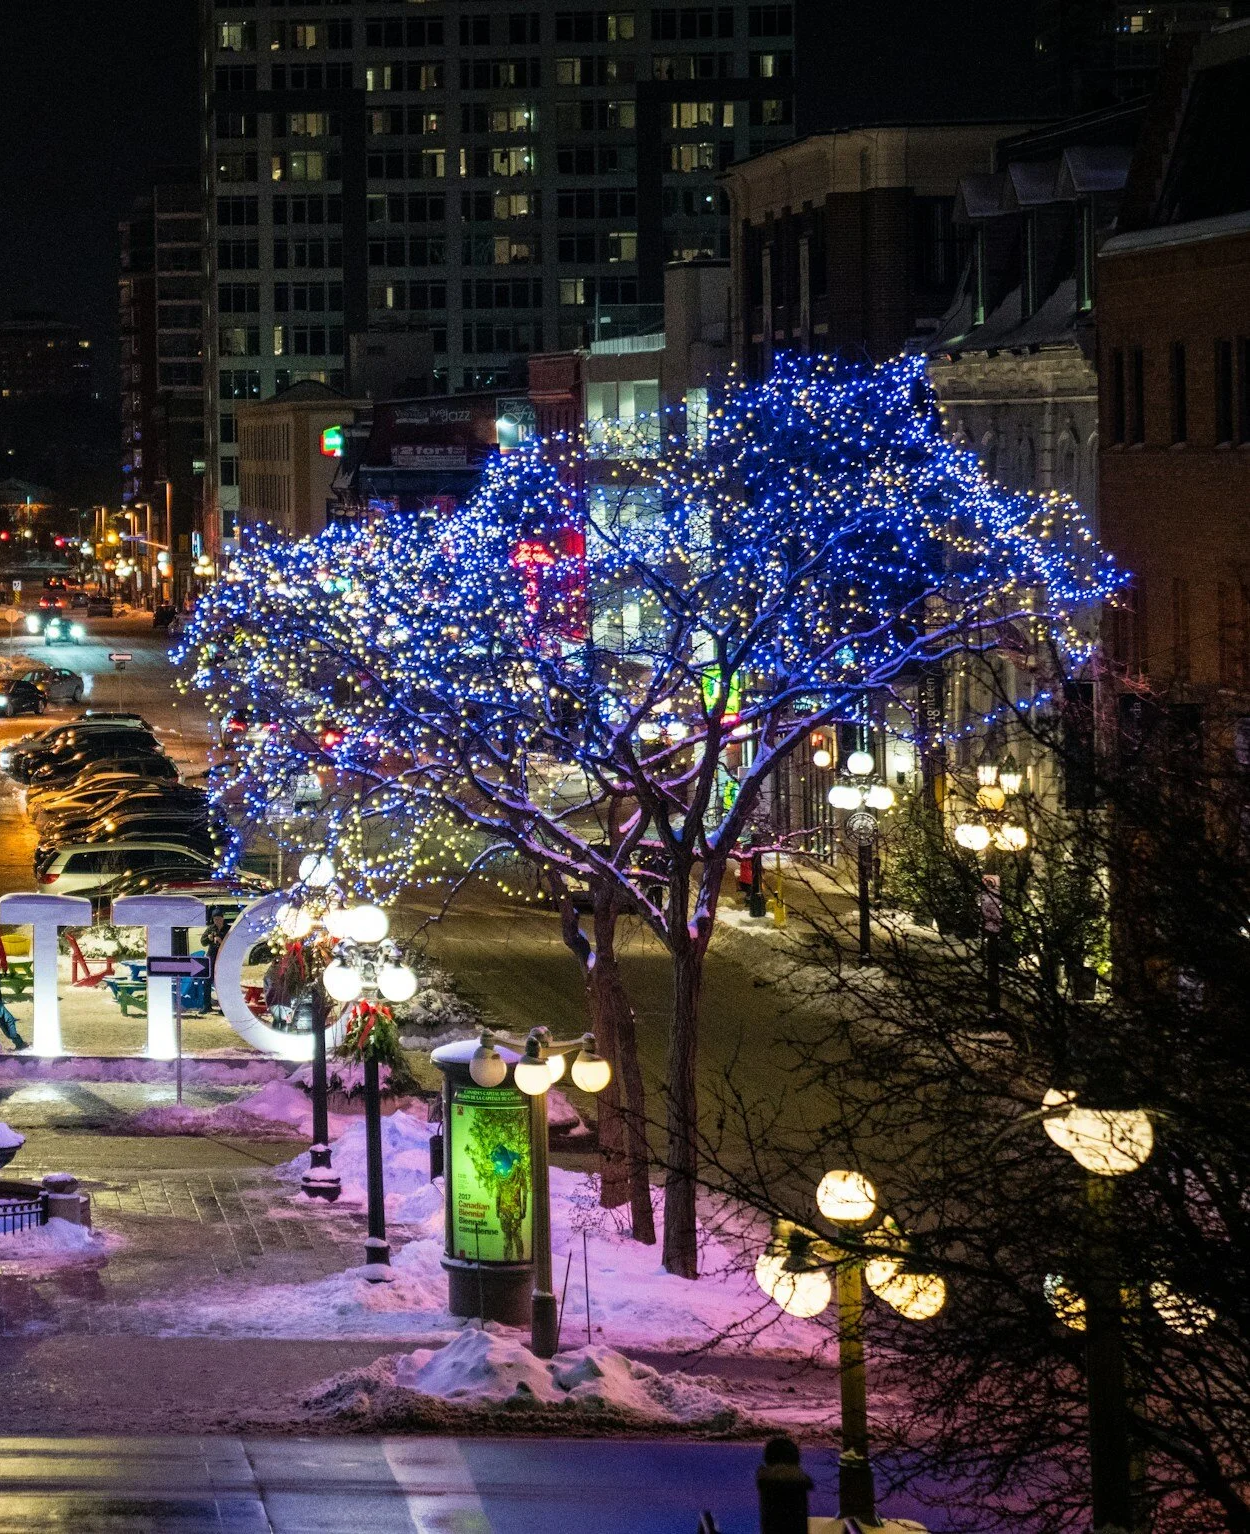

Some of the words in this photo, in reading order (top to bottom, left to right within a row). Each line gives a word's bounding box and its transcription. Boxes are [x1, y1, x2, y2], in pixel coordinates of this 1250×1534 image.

[458, 1200, 490, 1211] Canadian
[458, 1208, 486, 1218] Biennial
[458, 1217, 488, 1226] Biennale
[458, 1226, 499, 1236] canadienne
